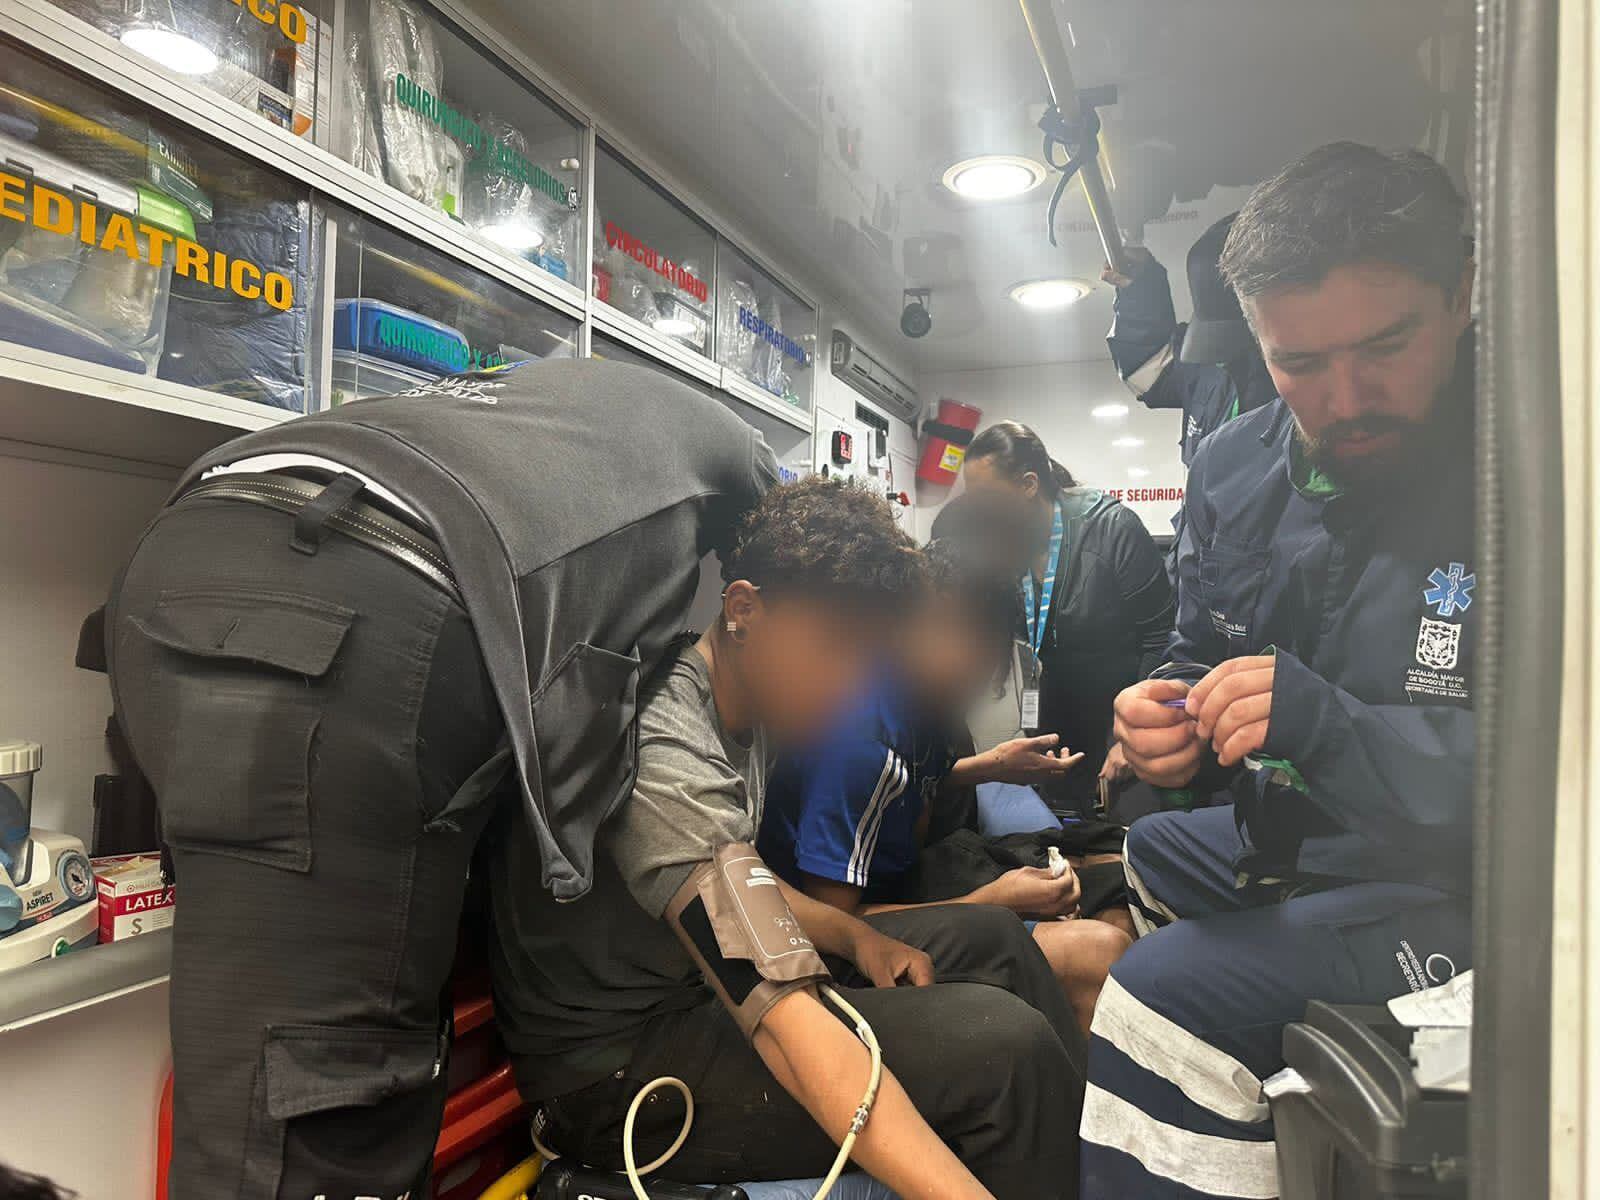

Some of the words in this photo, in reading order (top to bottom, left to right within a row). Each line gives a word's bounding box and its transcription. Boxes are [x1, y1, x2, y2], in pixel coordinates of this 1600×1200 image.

[0, 171, 294, 312] EDIATRICO
[605, 220, 708, 304] CIRCULATORIO
[739, 306, 805, 365] RESPIRATORIO
[1127, 487, 1184, 502] SEGURIDA
[125, 890, 173, 912] LATEX
[130, 917, 143, 936] S
